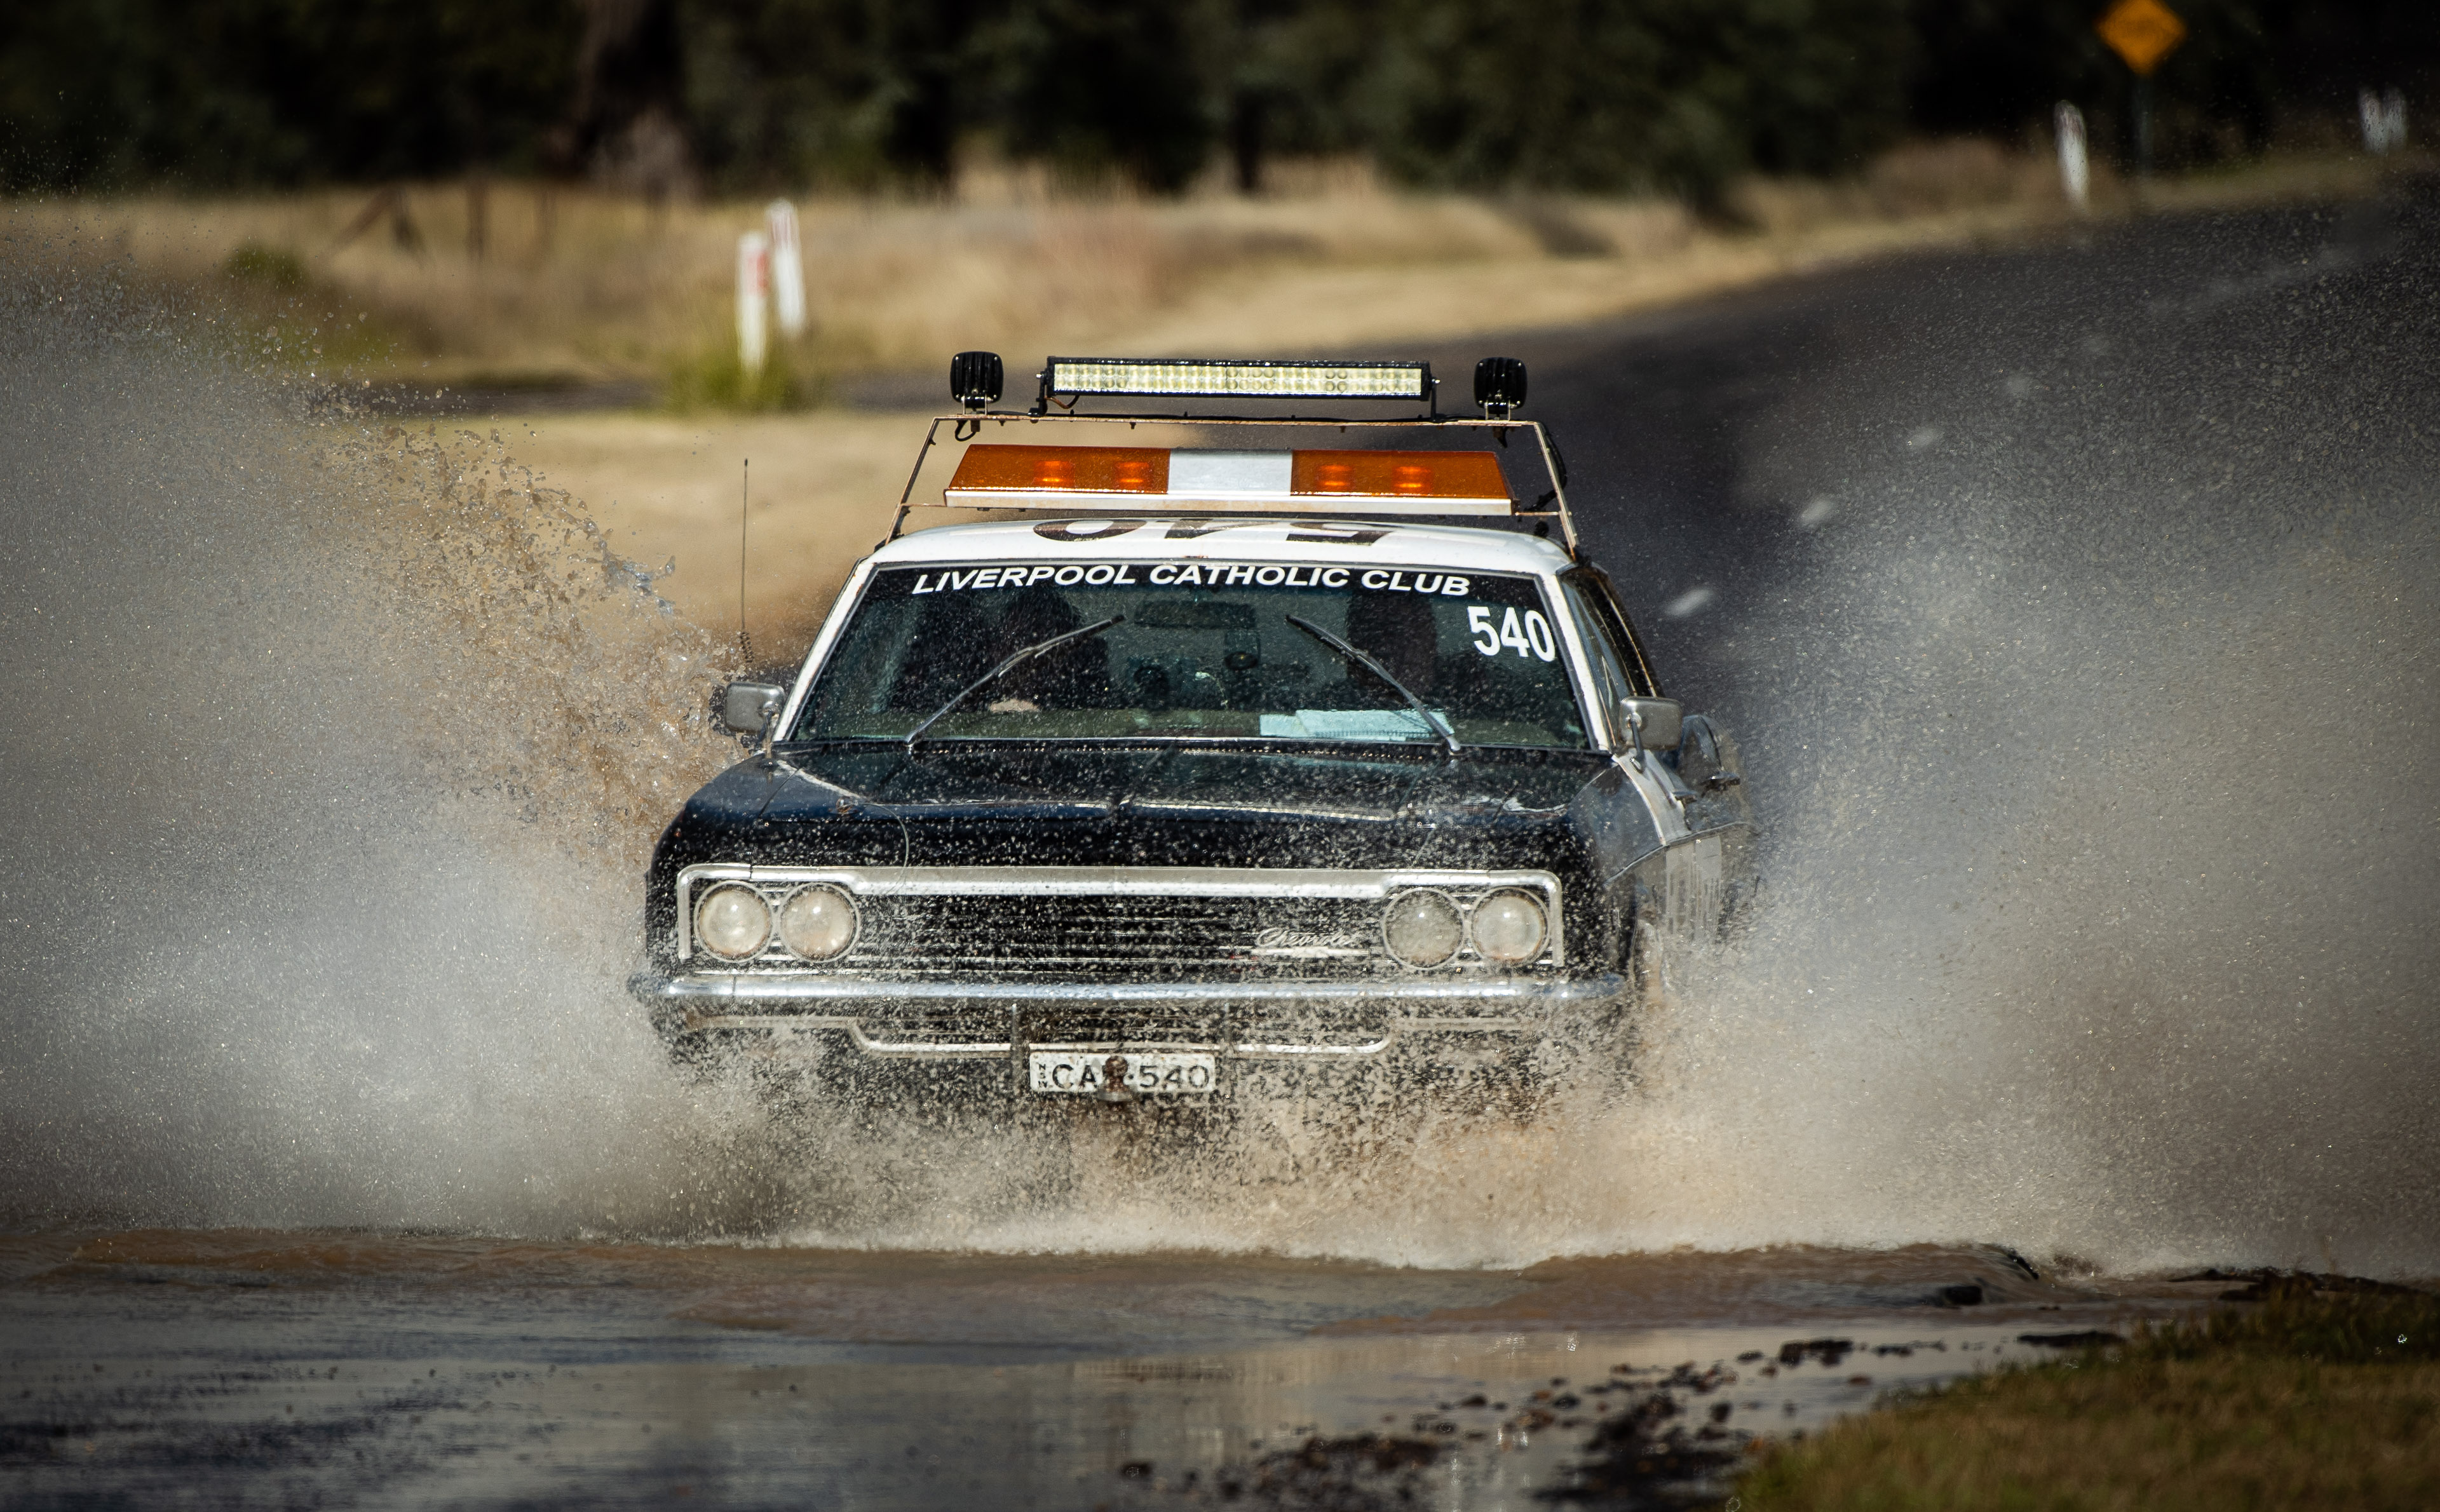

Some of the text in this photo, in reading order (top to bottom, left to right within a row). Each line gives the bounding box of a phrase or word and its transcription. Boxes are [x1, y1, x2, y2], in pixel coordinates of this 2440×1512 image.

[912, 564, 1470, 596] LIVERPOOL CATHOLIC CLUB
[1467, 605, 1555, 662] 540
